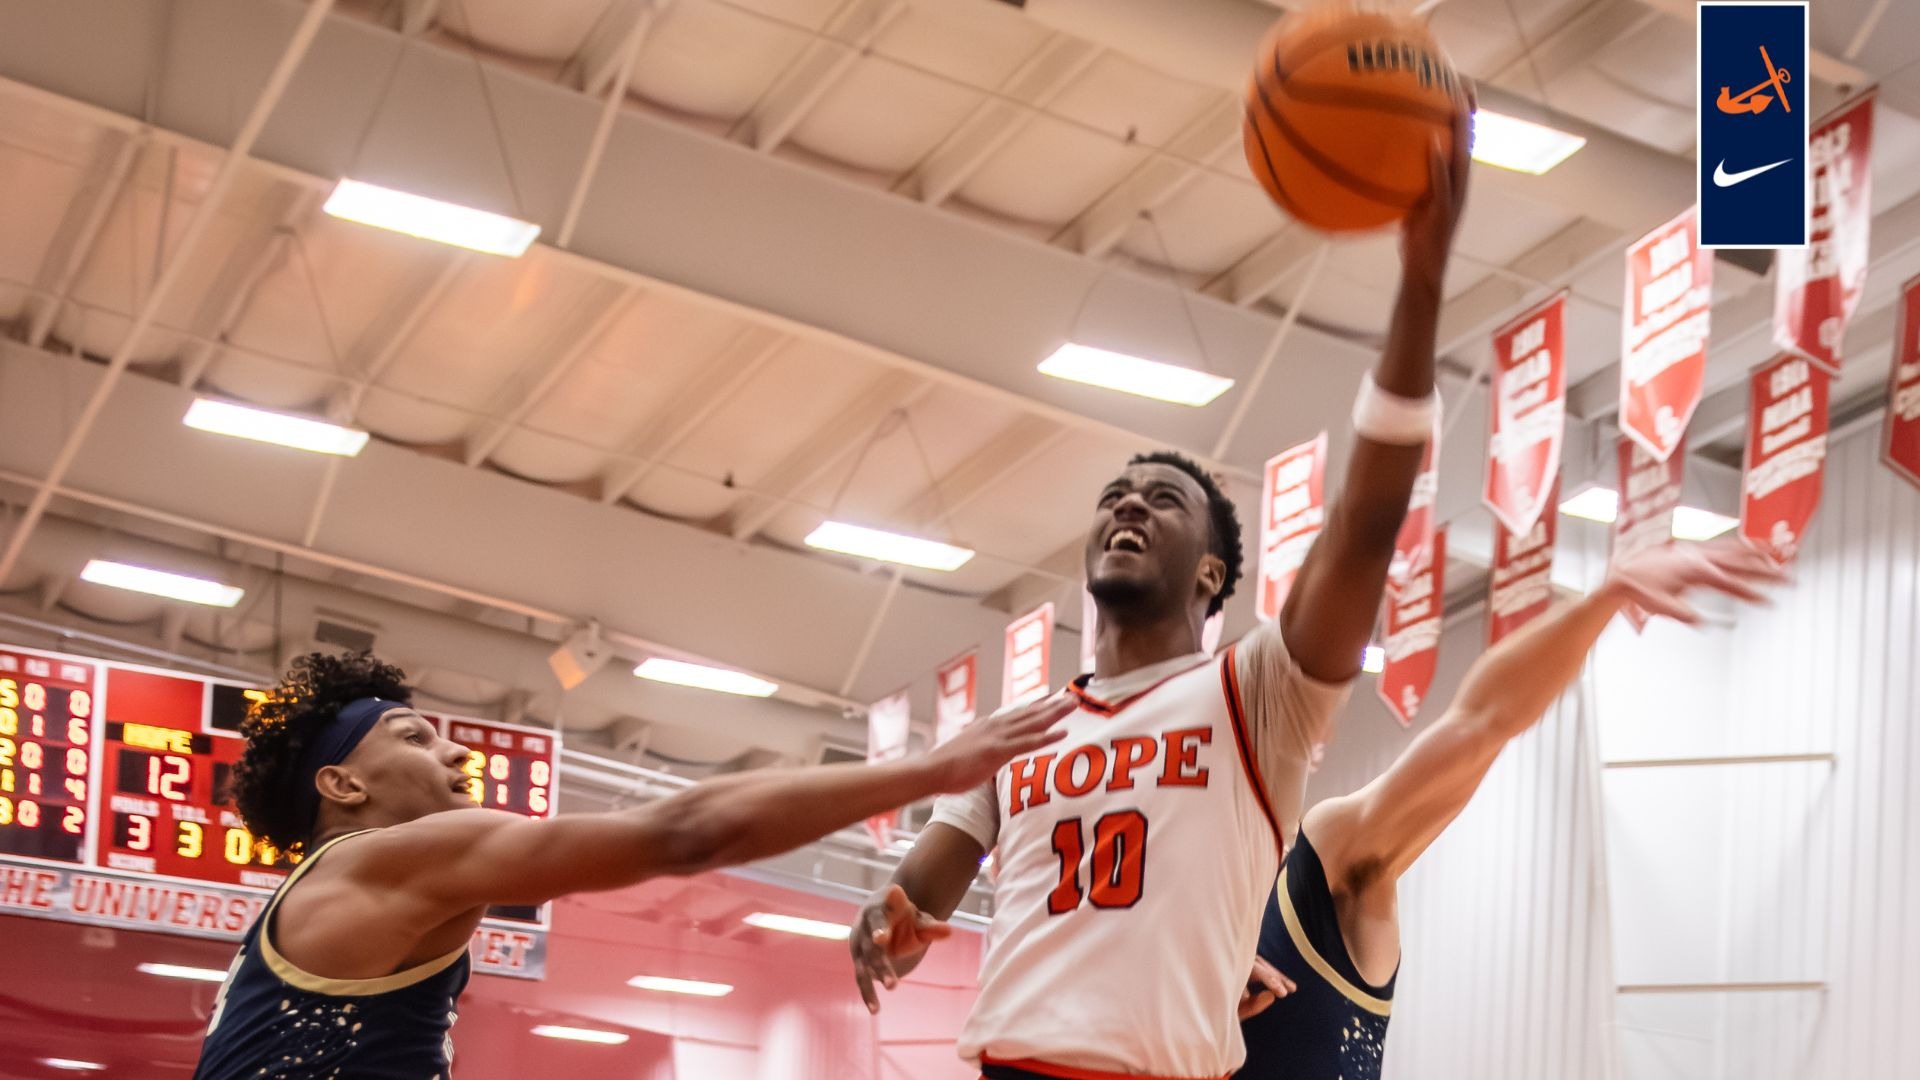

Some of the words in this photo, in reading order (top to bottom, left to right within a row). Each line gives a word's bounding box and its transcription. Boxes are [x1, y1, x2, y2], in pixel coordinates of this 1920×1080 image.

[148, 755, 190, 800] 12
[1009, 726, 1213, 818] HOPE
[62, 805, 85, 834] 2
[127, 814, 151, 850] 3
[177, 820, 203, 858] 3
[1047, 809, 1149, 917] 10
[0, 868, 58, 909] HE
[476, 929, 534, 968] ET
